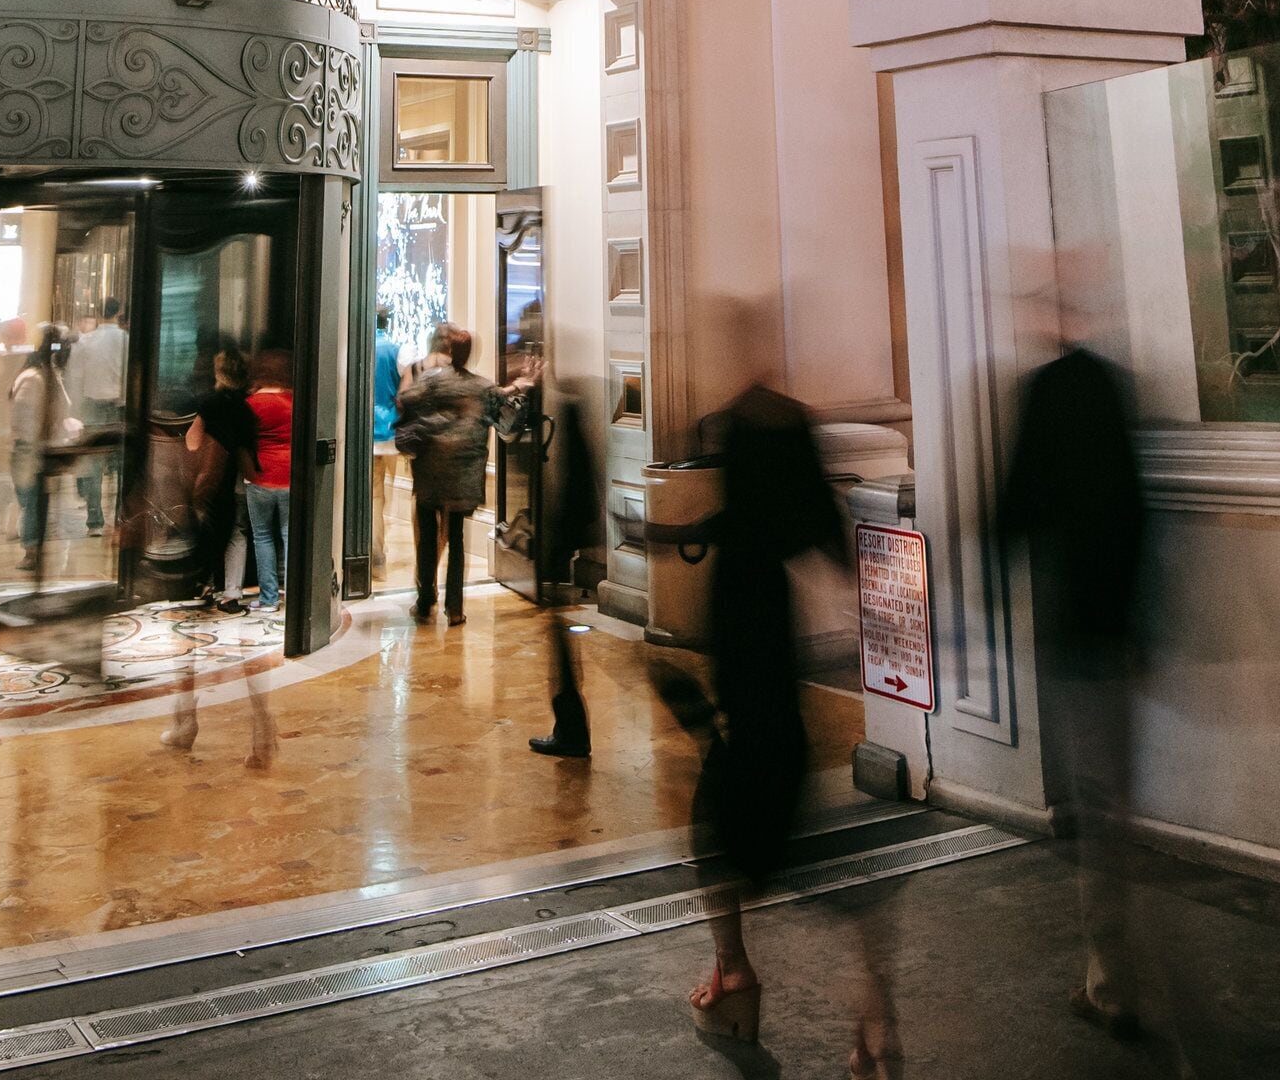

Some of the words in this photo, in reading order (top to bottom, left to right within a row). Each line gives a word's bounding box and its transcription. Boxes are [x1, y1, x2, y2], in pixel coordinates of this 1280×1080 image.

[858, 531, 885, 551] RESORT
[864, 563, 889, 580] PERMITTED
[906, 558, 921, 572] USES
[889, 584, 895, 595] AT
[897, 586, 923, 603] LOCATIONS
[863, 592, 904, 613] DESIGNATED
[906, 602, 915, 615] BY
[917, 605, 922, 617] A
[863, 628, 889, 645] HOLIDAY
[894, 636, 926, 654] WEEKENDS
[867, 653, 885, 667] FRIDAY
[904, 664, 926, 679] SUNDAY
